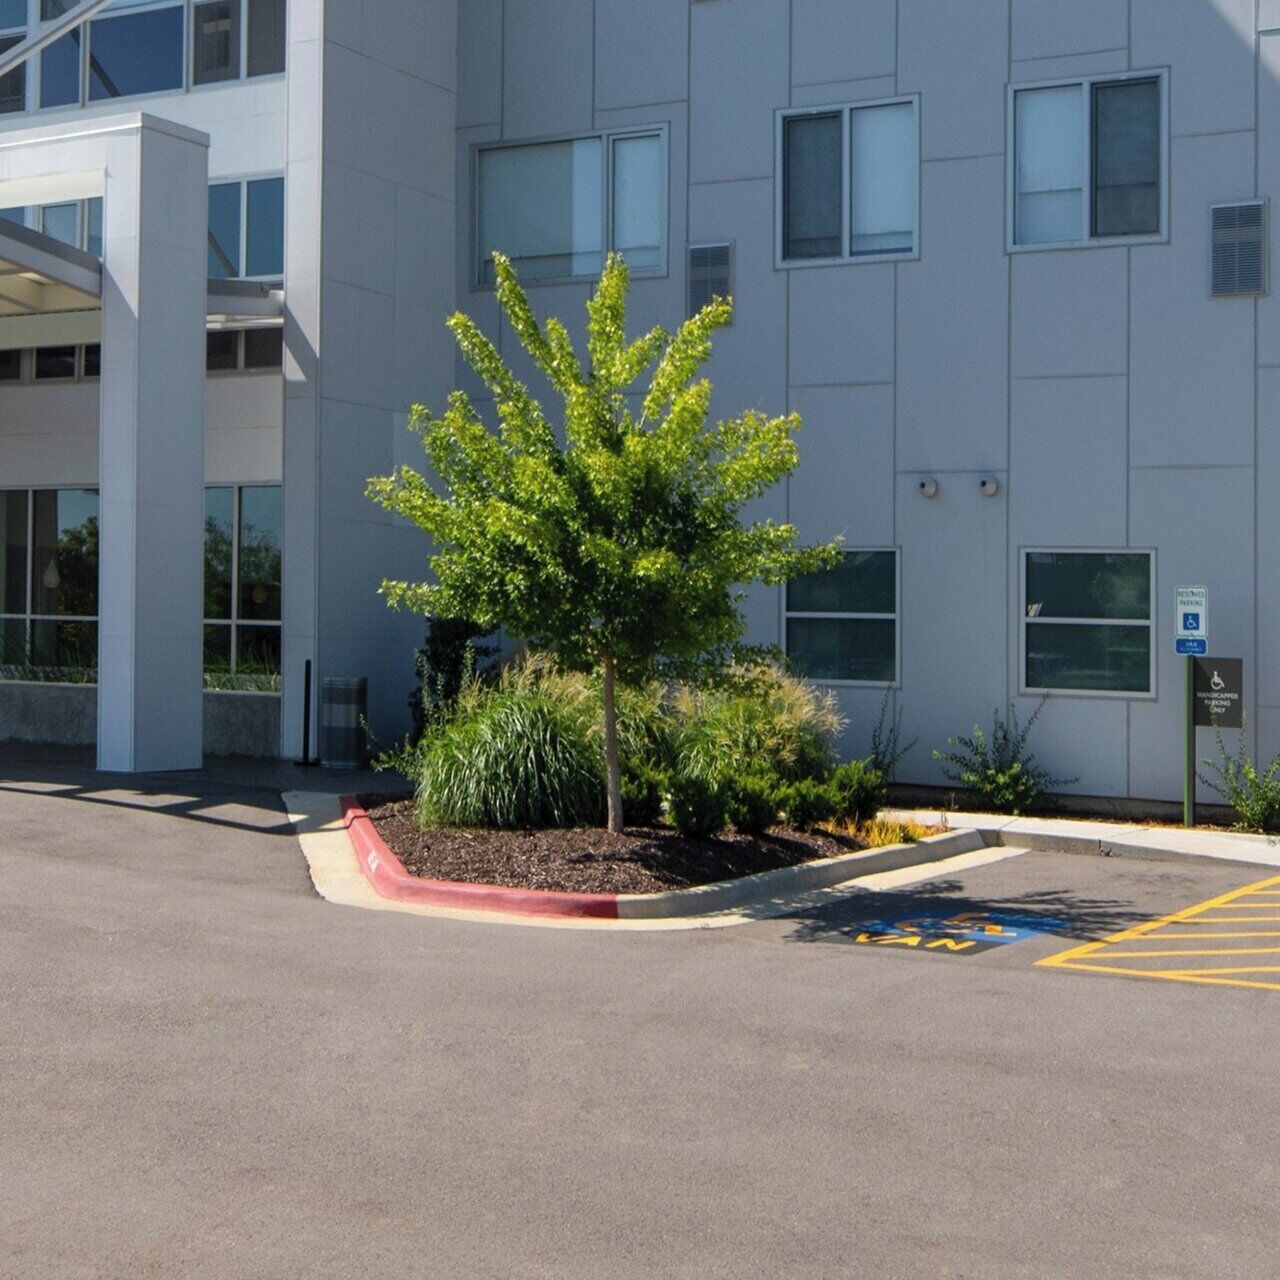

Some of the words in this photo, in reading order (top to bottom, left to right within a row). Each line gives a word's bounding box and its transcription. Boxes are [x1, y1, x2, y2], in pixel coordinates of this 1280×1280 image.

[1179, 599, 1204, 607] PARKING
[1197, 692, 1239, 700] HANDICAPPED
[1204, 699, 1231, 707] PARKING
[855, 932, 977, 951] VAN
